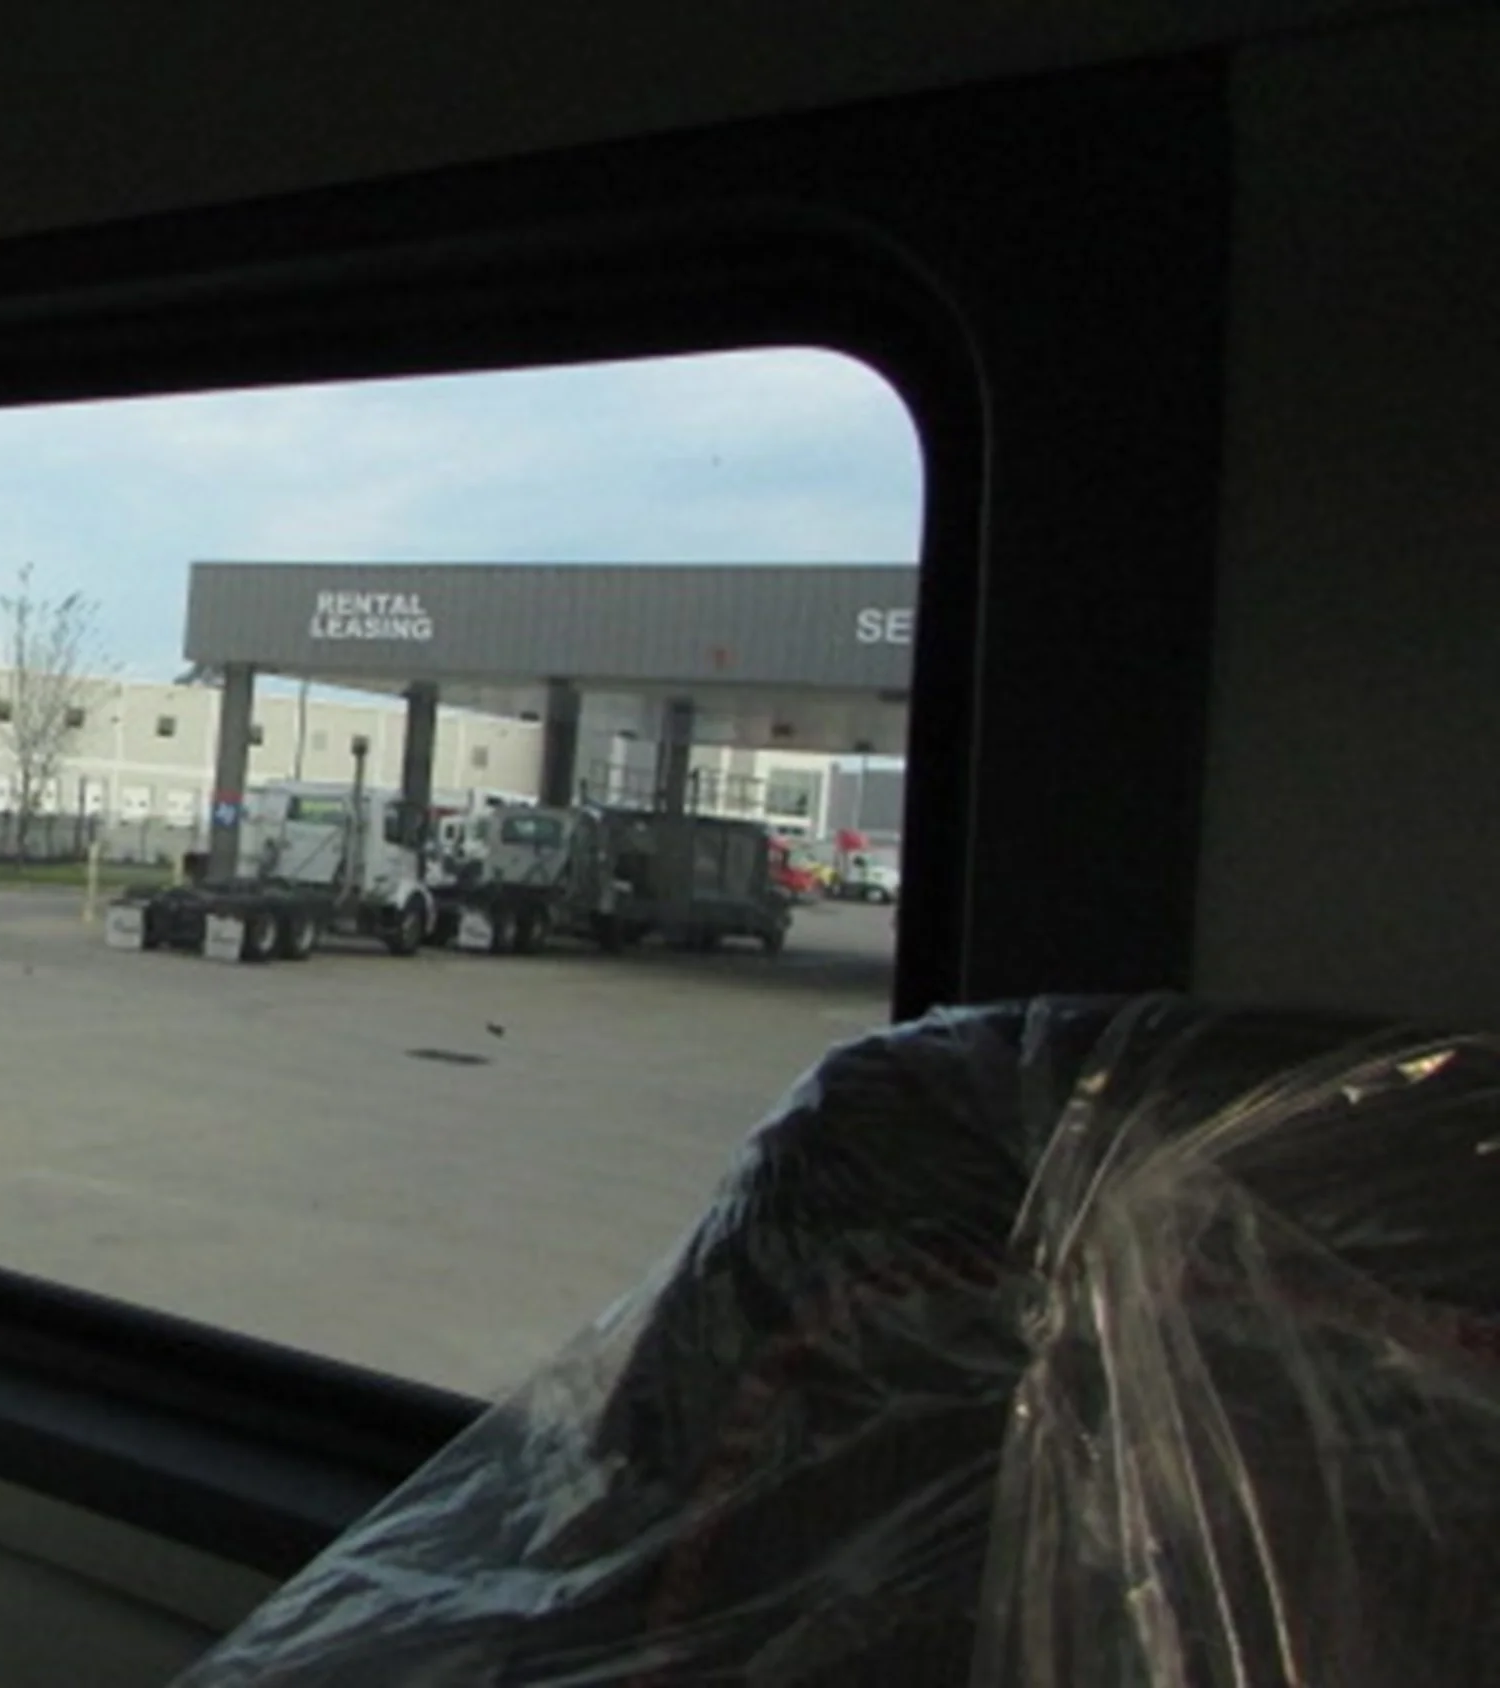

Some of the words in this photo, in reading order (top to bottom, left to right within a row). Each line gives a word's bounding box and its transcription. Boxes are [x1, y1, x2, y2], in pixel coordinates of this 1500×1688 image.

[317, 592, 426, 615] RENTAL
[310, 616, 433, 639] LEASING
[856, 608, 913, 643] SE
